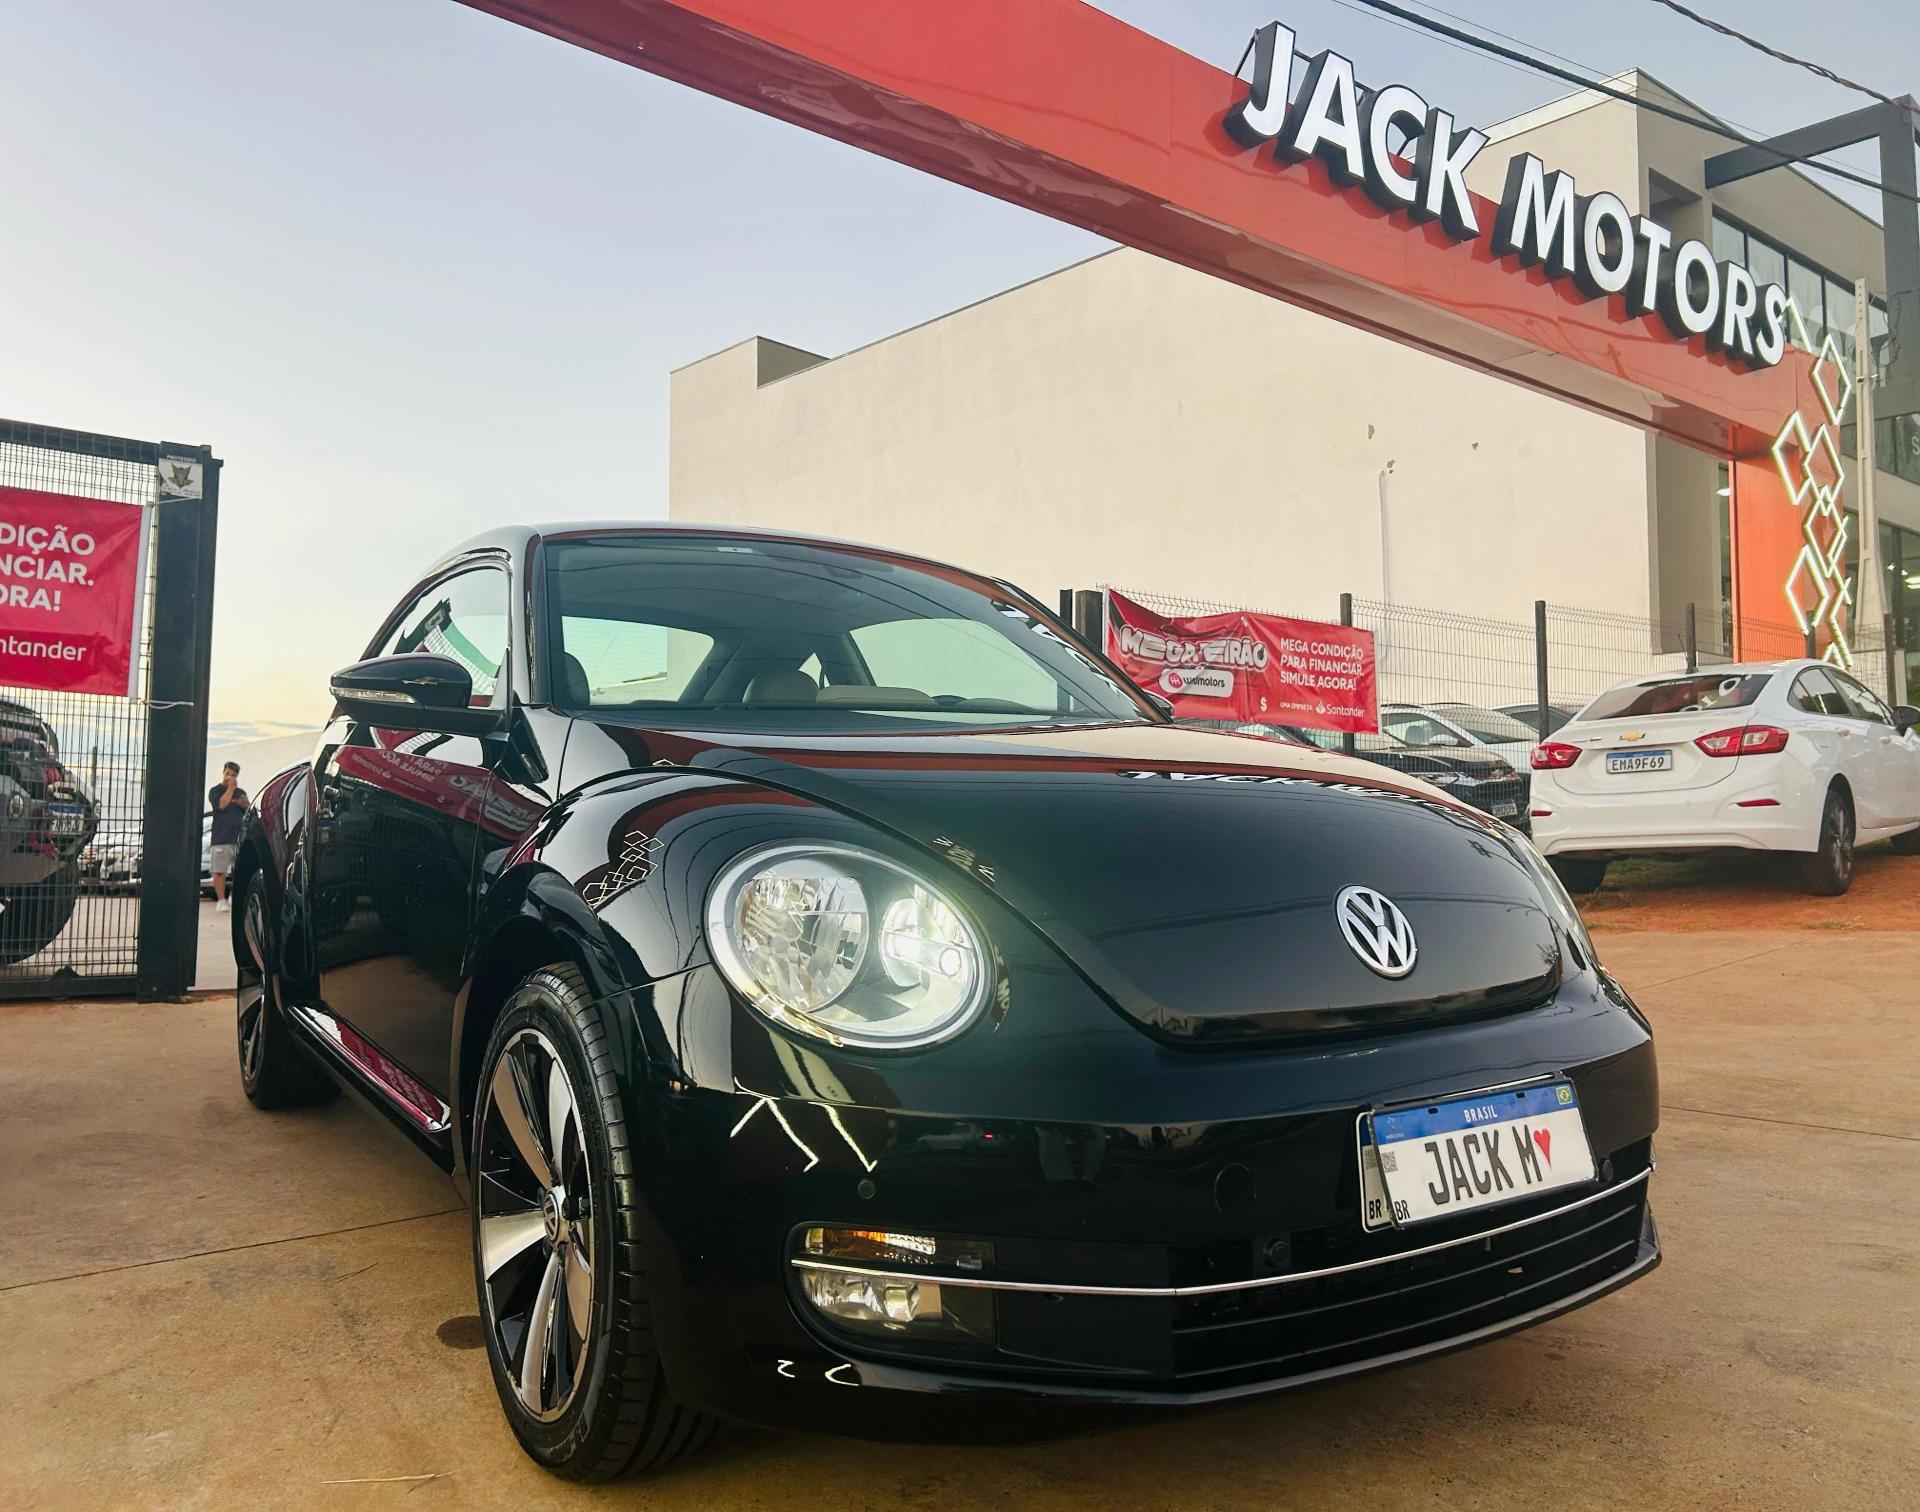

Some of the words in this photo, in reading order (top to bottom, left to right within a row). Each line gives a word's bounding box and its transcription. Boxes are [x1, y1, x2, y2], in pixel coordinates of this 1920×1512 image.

[1240, 20, 1490, 238] JACK
[1508, 152, 1787, 368] MOTORS
[0, 522, 95, 555] DIÇÃO
[1280, 638, 1309, 653] MEGA
[1310, 642, 1364, 661] CONDIÇÃO
[1280, 654, 1307, 671] PARA
[1280, 671, 1315, 687] SIMULE
[1317, 676, 1357, 690] AGORA!
[1326, 704, 1365, 718] Santander
[1463, 1104, 1498, 1123] BRASIL
[1424, 1129, 1514, 1206] JACK
[1511, 1124, 1543, 1185] M
[1368, 1198, 1382, 1220] BR
[1394, 1199, 1411, 1221] BR
